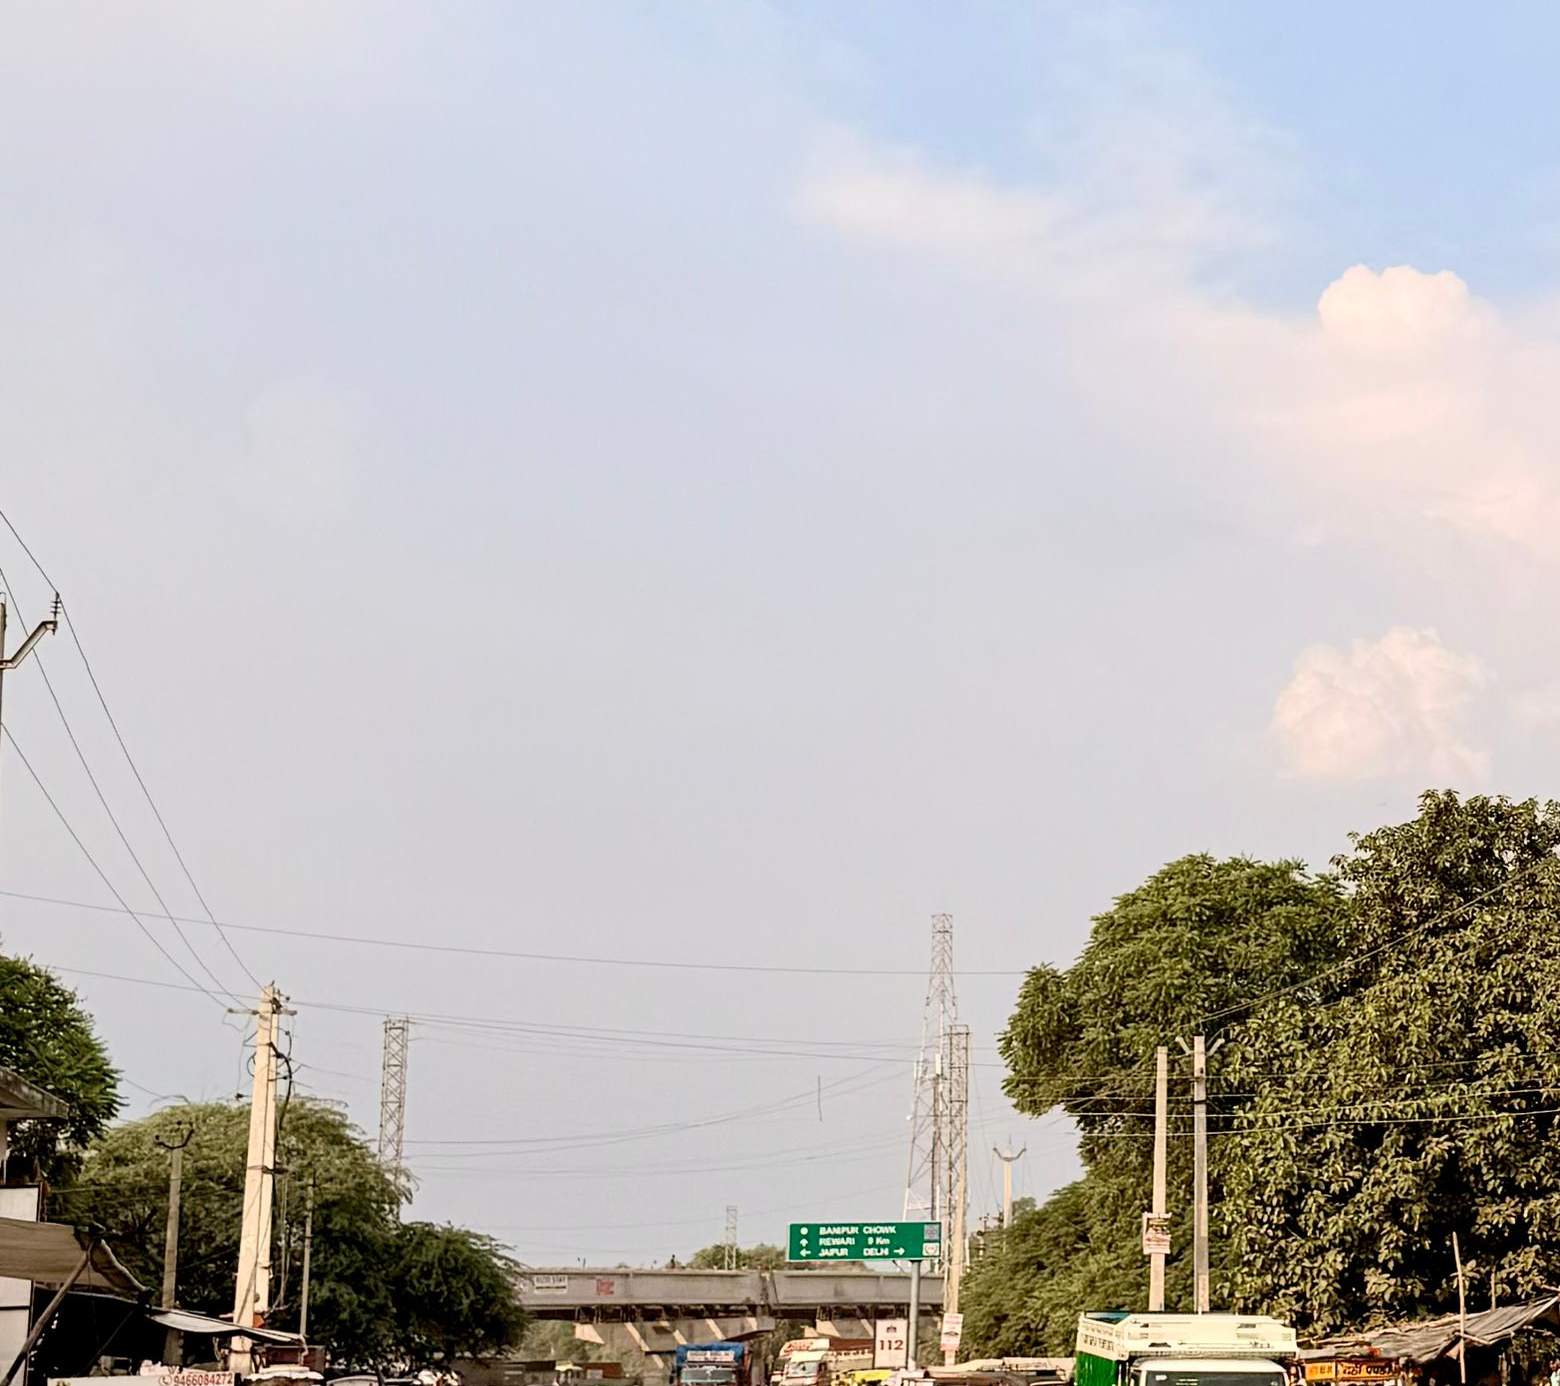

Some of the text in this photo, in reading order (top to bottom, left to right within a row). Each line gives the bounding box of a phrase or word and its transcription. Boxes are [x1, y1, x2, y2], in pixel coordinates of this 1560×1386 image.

[863, 1225, 897, 1234] CHOWK
[819, 1237, 855, 1246] REWARI
[875, 1237, 890, 1245] Km
[819, 1248, 889, 1257] JAIPUR DELHI
[879, 1339, 905, 1351] 112
